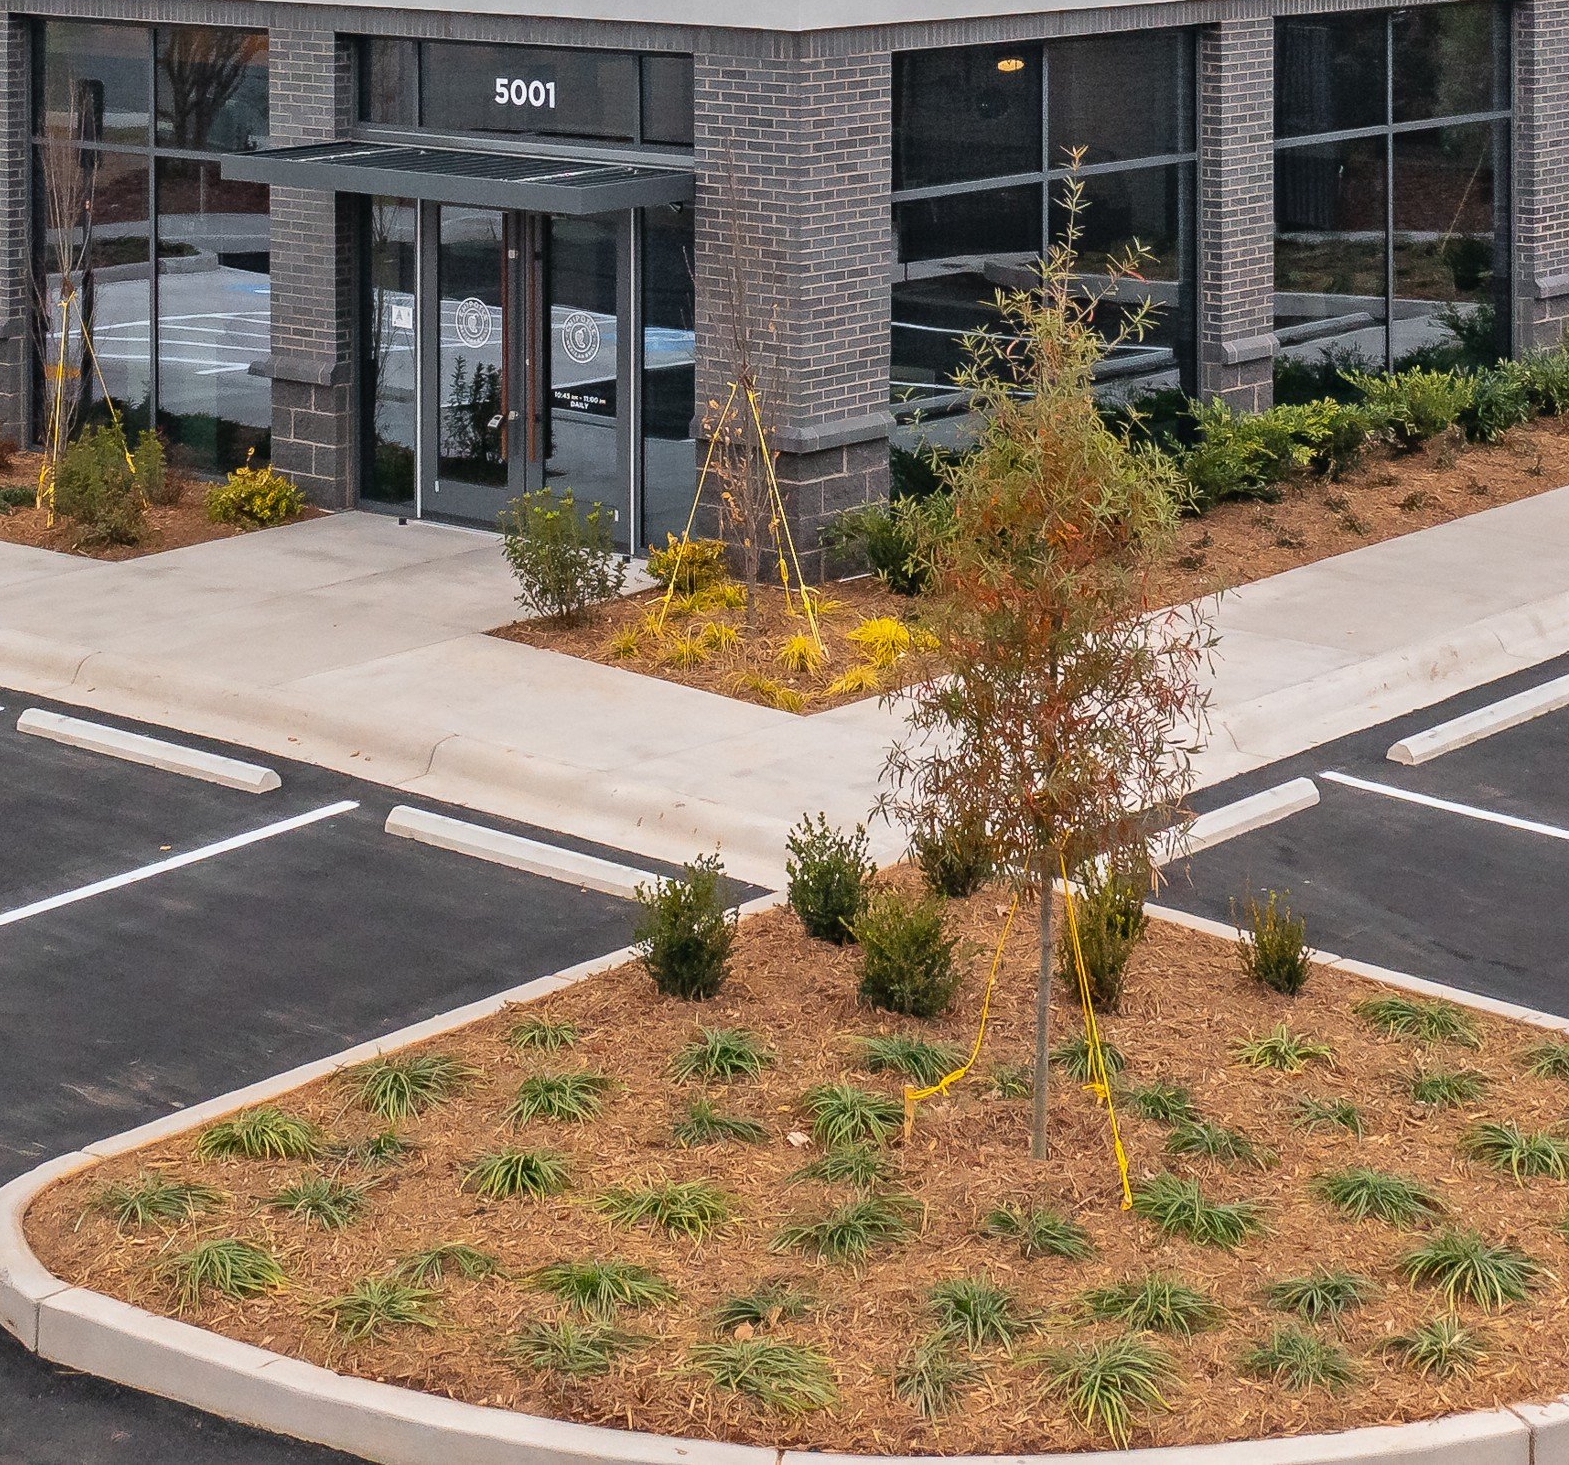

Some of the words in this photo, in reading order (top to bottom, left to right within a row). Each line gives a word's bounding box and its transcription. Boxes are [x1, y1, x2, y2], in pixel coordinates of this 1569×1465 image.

[494, 77, 557, 109] 5001
[554, 391, 571, 400] 10:45
[583, 395, 599, 404] 11:00
[570, 401, 589, 410] DAILY
